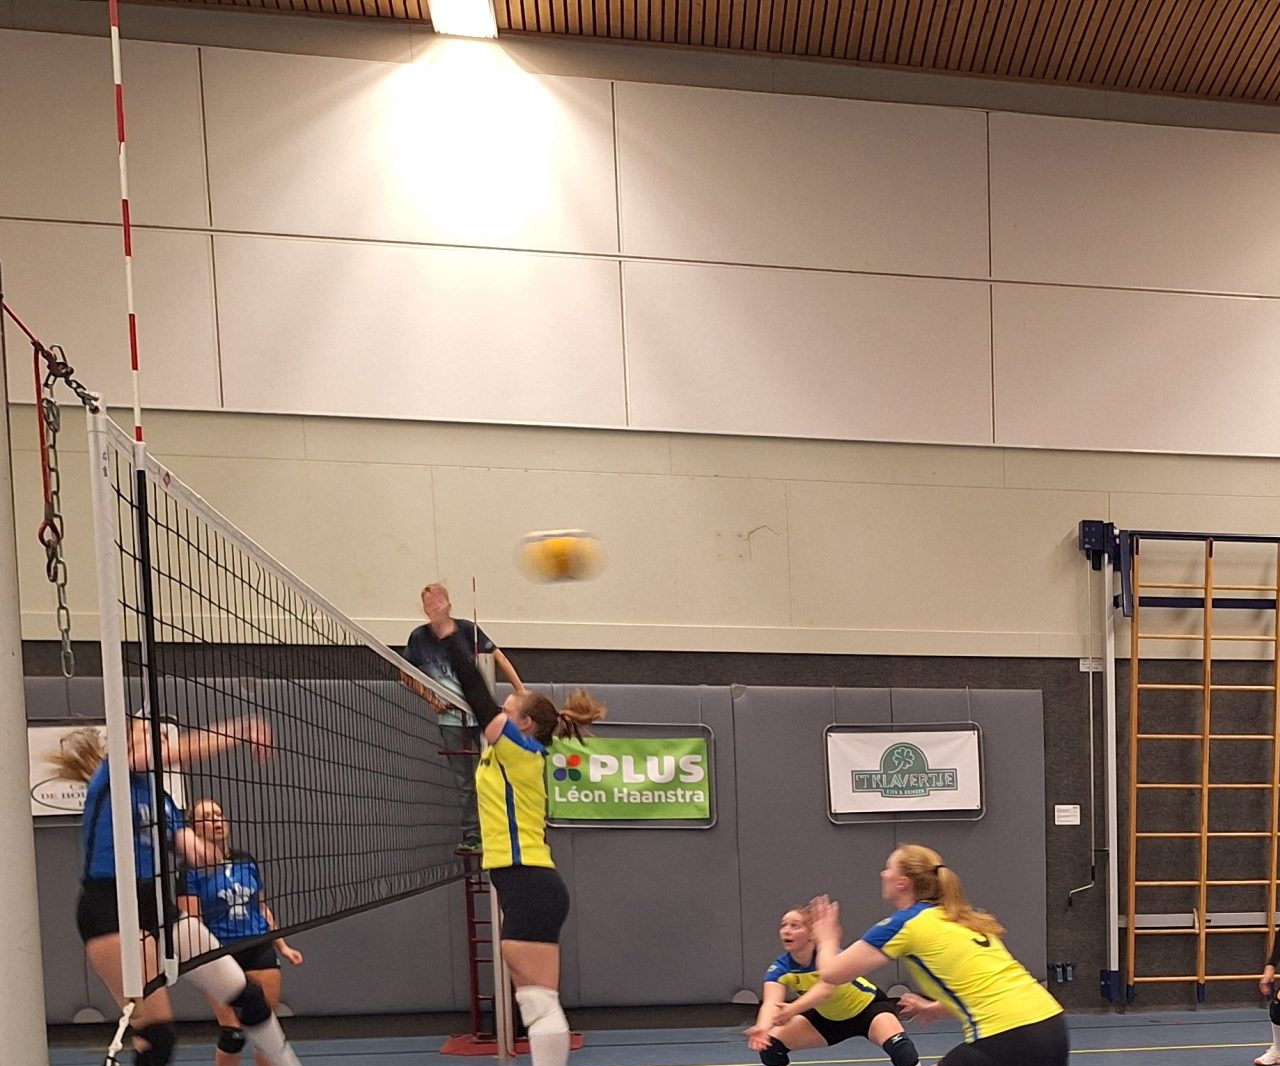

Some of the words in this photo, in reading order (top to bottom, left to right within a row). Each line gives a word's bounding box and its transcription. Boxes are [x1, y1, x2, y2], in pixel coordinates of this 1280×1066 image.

[589, 754, 705, 784] PLUS
[871, 772, 954, 788] KLAVERTJE
[554, 785, 607, 803] Léon
[613, 787, 705, 803] Haanstra
